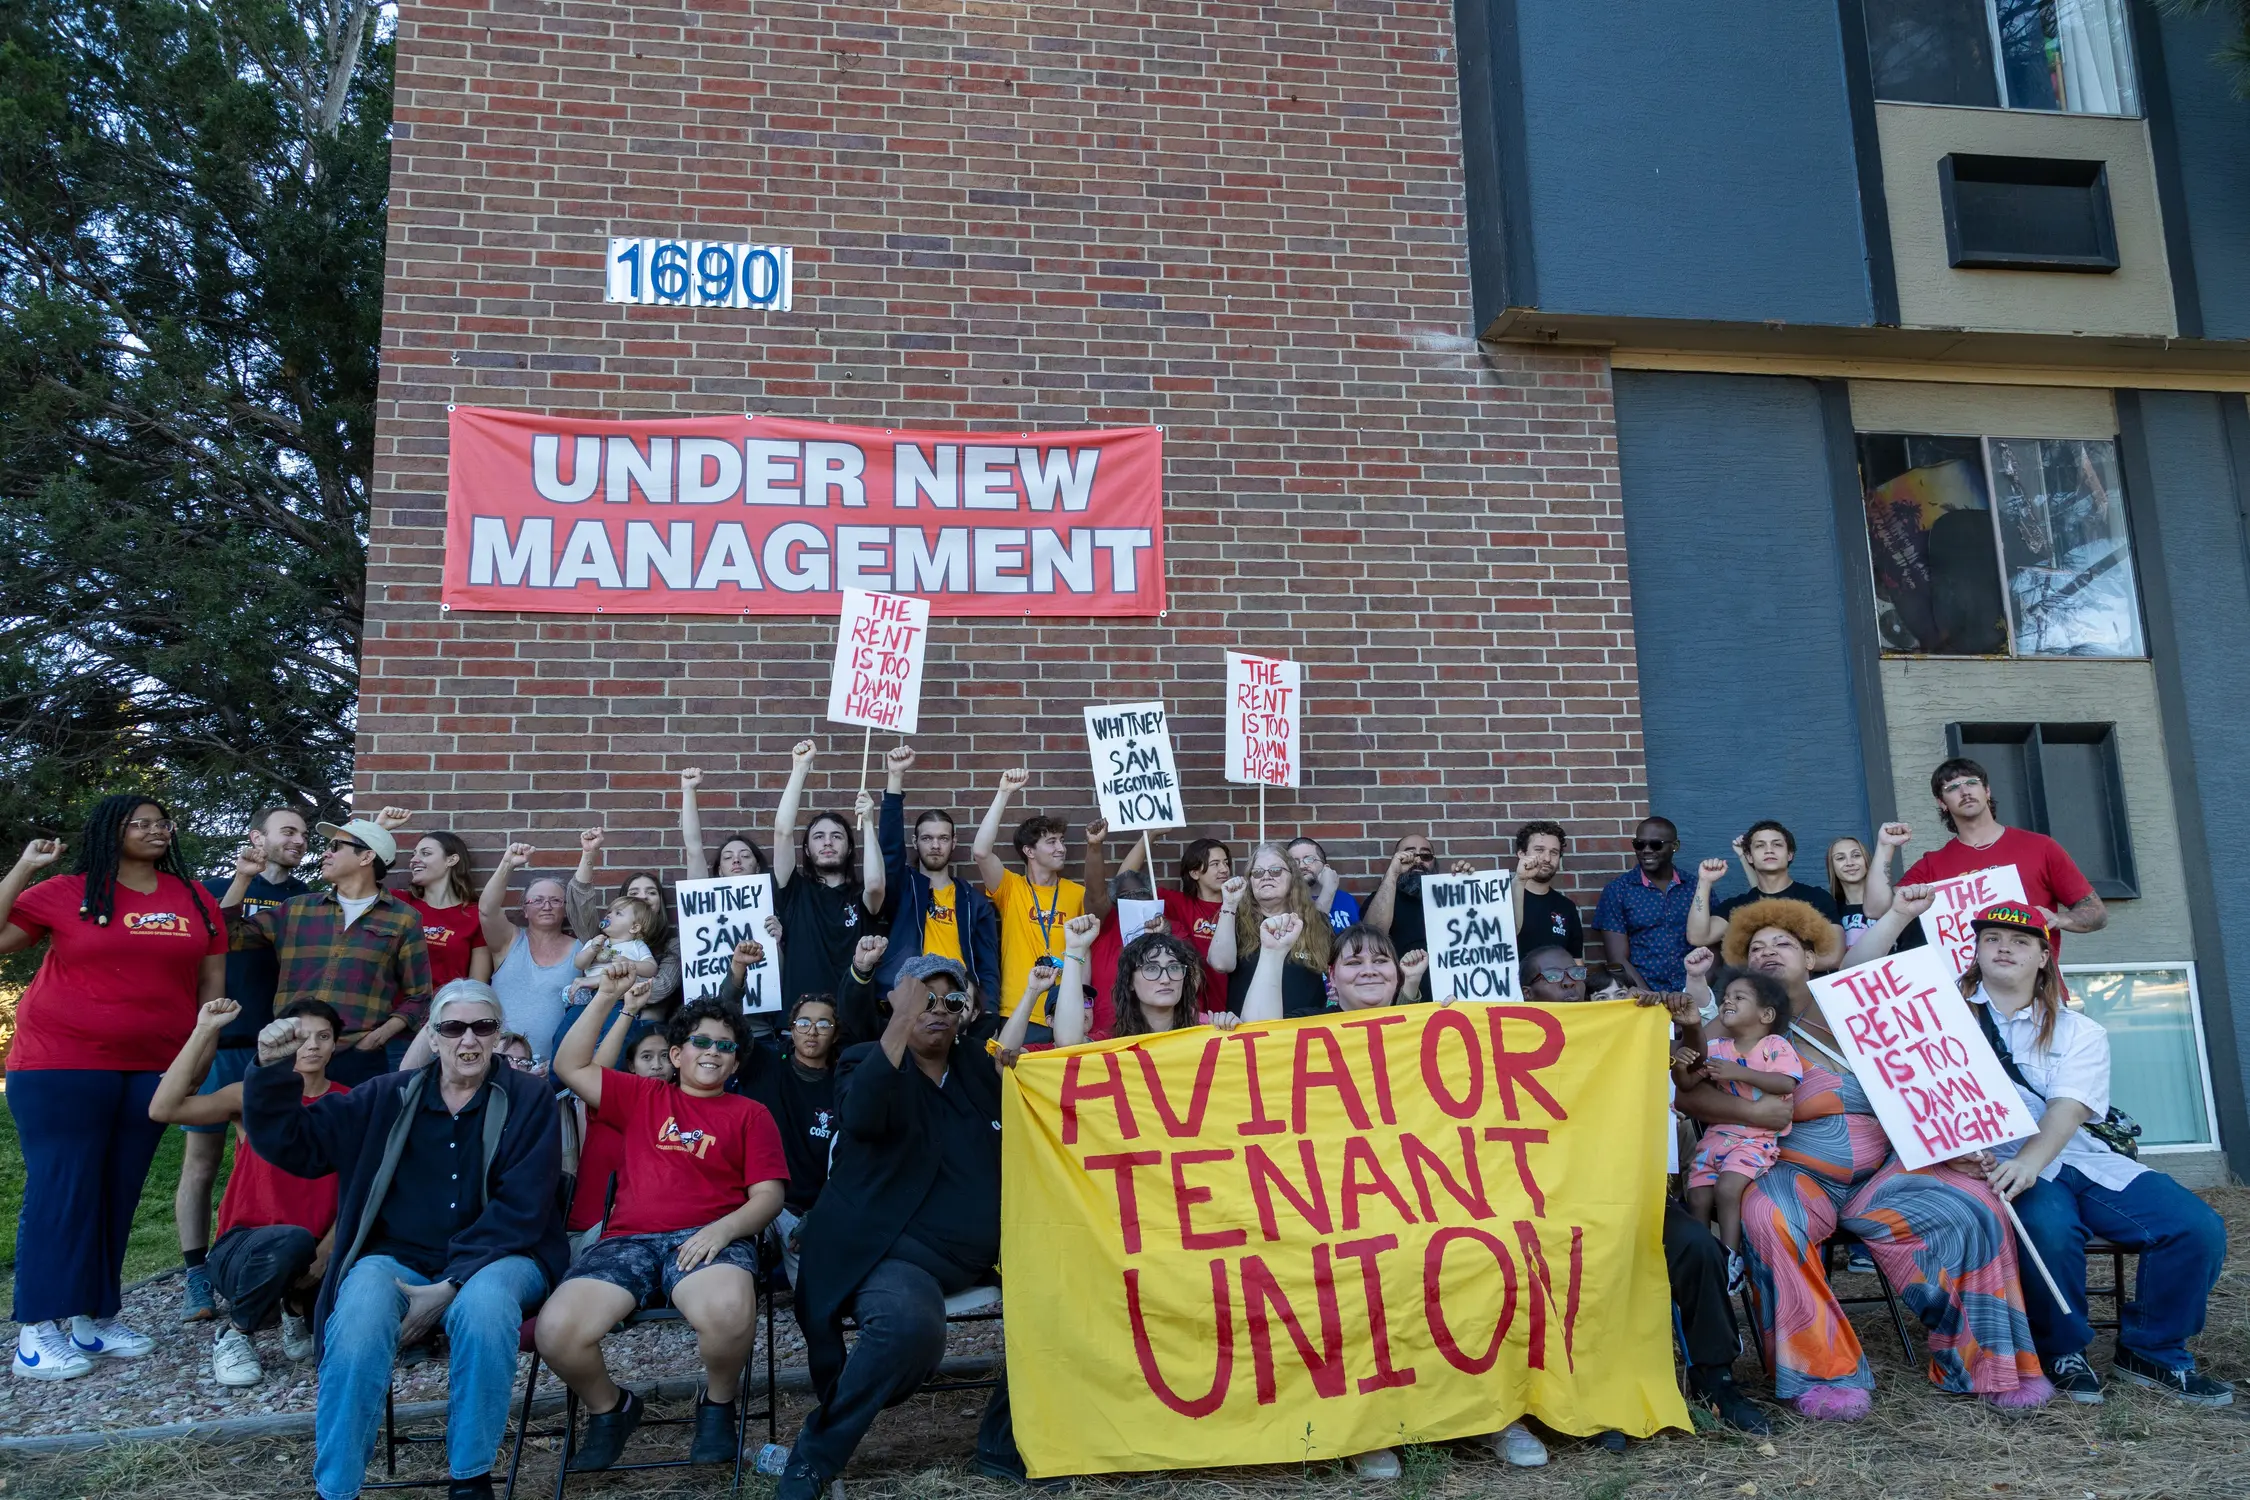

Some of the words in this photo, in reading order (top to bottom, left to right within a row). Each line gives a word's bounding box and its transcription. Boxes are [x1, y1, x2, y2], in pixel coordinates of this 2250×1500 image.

[617, 244, 780, 303] 1690
[531, 435, 868, 508] UNDER
[894, 442, 1100, 511] NEW
[467, 515, 1153, 595] MANAGEMENT
[865, 592, 911, 622] THE
[851, 616, 921, 654] RENT
[852, 646, 873, 669] IS
[877, 651, 910, 680] TOO
[1240, 659, 1283, 685] THE
[852, 670, 902, 703] DAMN
[1237, 683, 1293, 715] RENT
[845, 693, 903, 728] HIGH!
[1092, 711, 1163, 740] WHITNEY
[1242, 713, 1259, 734] IS
[1260, 714, 1290, 739] TOO
[1109, 746, 1161, 776] SAM
[1246, 735, 1286, 761] DAMN
[1102, 771, 1174, 795] NEGOTIATE
[1243, 757, 1290, 787] HIGH!
[1119, 792, 1173, 825] NOW
[680, 884, 763, 917] WHITNEY
[1432, 877, 1511, 908] WHITNEY
[1935, 875, 1997, 910] THE
[1446, 917, 1502, 947] SAM
[1936, 910, 1979, 946] RE
[1987, 907, 2031, 925] GOAT
[696, 922, 754, 956] SAM
[1437, 943, 1515, 969] NEGOTIATE
[701, 973, 762, 1007] NW
[1453, 967, 1510, 999] NOW
[1831, 960, 1913, 1008] THE
[1845, 987, 1943, 1055] RENT
[1060, 1005, 1569, 1146] AVIATOR
[1873, 1049, 1916, 1090] IS
[1905, 1036, 1969, 1076] TOO
[1899, 1070, 1986, 1124] DAMN
[809, 1126, 831, 1139] COST
[1083, 1124, 1550, 1255] TENANT
[1122, 1220, 1584, 1421] UNION
